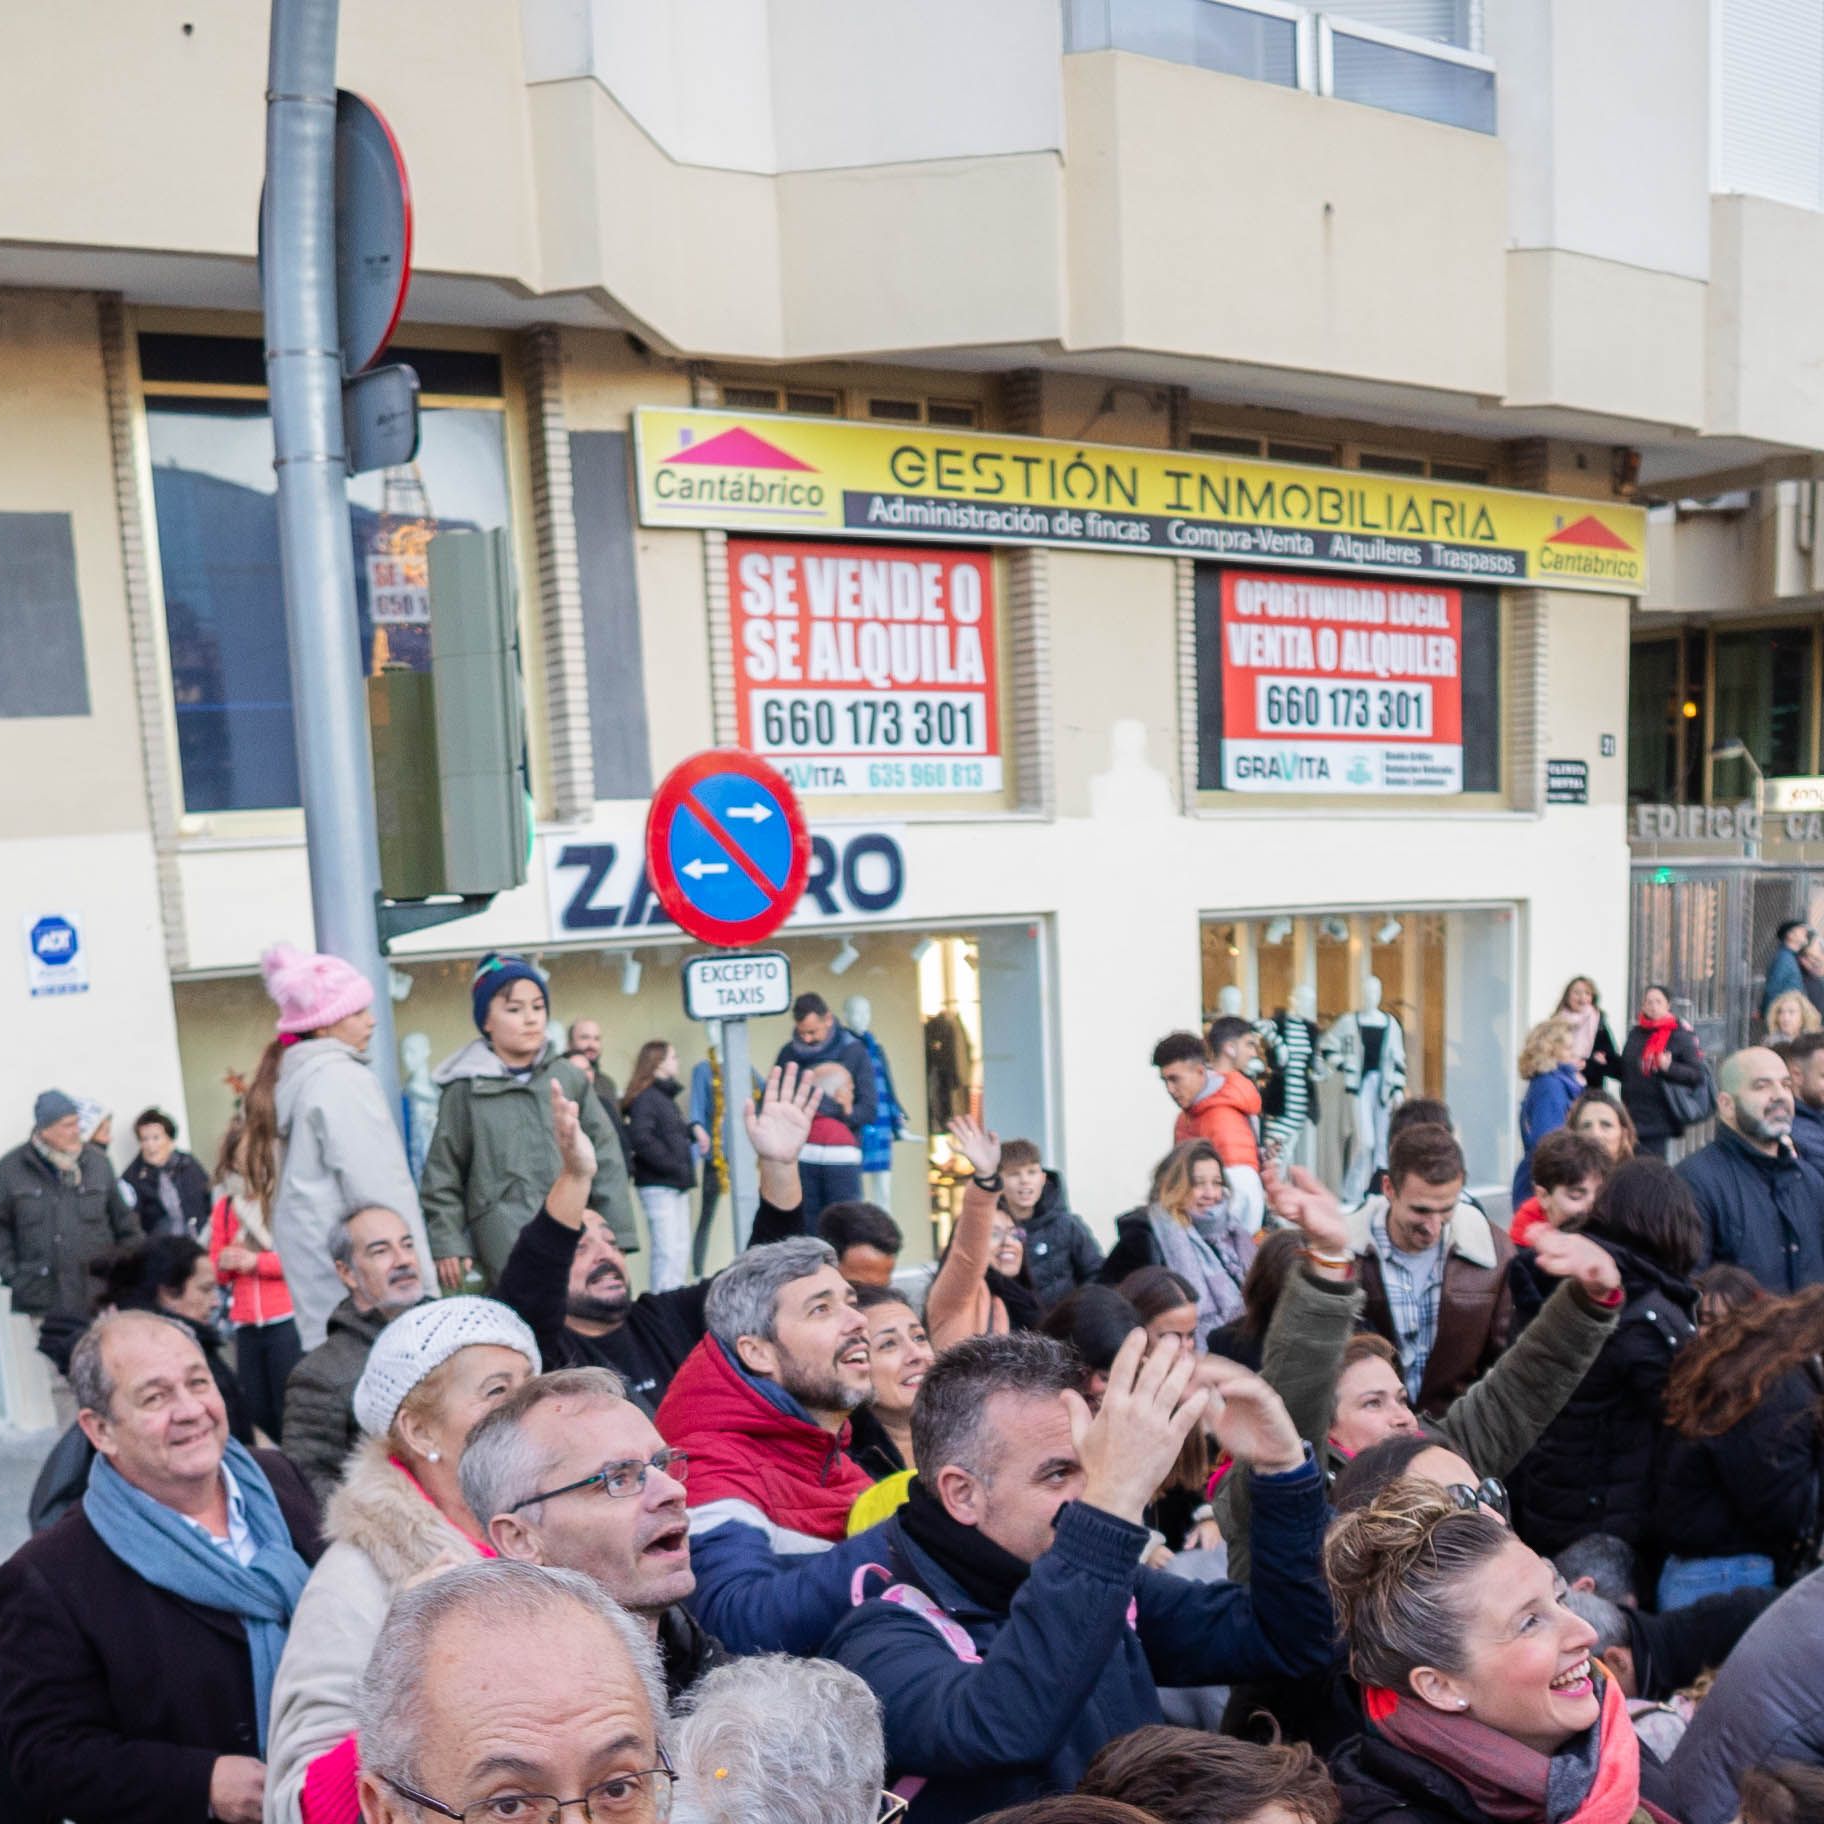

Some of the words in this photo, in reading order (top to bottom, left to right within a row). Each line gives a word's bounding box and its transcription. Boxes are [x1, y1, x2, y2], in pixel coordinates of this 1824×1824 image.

[653, 467, 826, 508] Cantábrico
[889, 445, 1140, 508] GESTIÓN
[1162, 468, 1499, 541] INMOBILIARIA
[867, 494, 1049, 536] Administración
[1052, 507, 1083, 538] de
[1085, 510, 1151, 543] fincas
[1167, 520, 1314, 557] Compra-Venta
[1327, 534, 1423, 571] Alquileres
[1432, 542, 1517, 575] Traspasos
[1539, 544, 1639, 579] Cantábrico
[738, 552, 801, 617] SE
[802, 556, 946, 622] VENDE
[949, 562, 983, 624] O
[1234, 577, 1387, 625] OPORTUNIDAD
[1387, 590, 1451, 629] LOCAL
[741, 617, 804, 682] SE
[807, 619, 987, 689] ALQUILA
[1226, 621, 1317, 670] VENTA
[1316, 626, 1339, 672] O
[1340, 630, 1458, 679] ALQUILER
[762, 699, 837, 746] 660
[845, 700, 904, 747] 173
[913, 701, 976, 747] 301
[1266, 685, 1319, 726] 660
[1329, 688, 1370, 728] 173
[1378, 689, 1424, 730] 301
[784, 763, 847, 788] AVITA
[867, 762, 906, 788] 635
[1235, 752, 1331, 781] GRAVITA
[1636, 804, 1761, 842] EDIFICIO
[700, 962, 778, 984] EXCEPTO
[716, 986, 766, 1005] TAXIS
